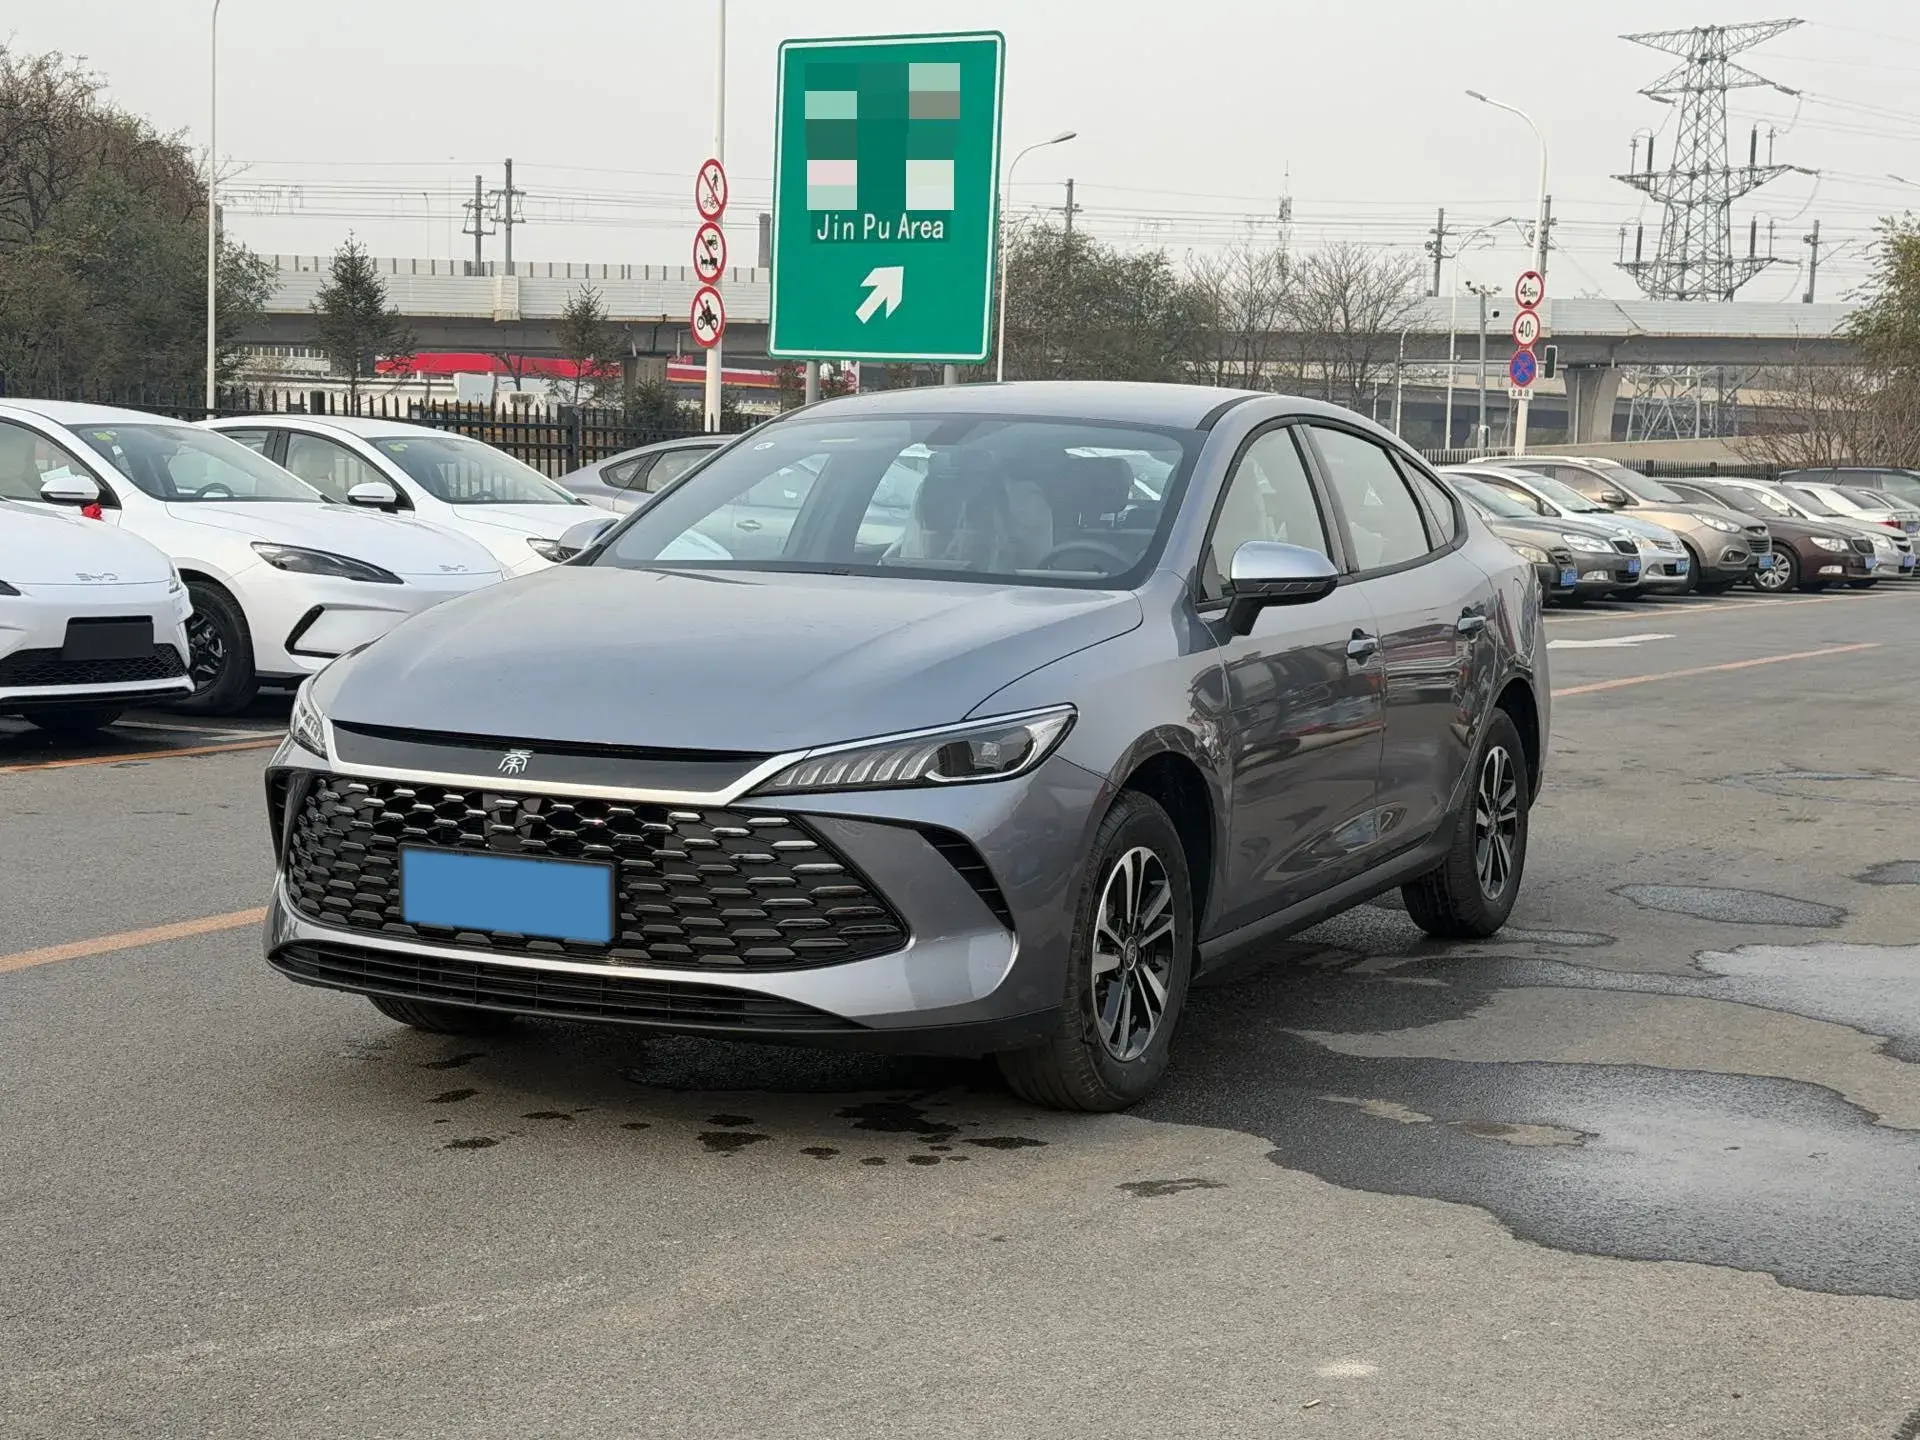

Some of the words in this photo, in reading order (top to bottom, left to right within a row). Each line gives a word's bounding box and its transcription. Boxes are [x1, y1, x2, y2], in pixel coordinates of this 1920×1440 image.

[817, 213, 854, 240] Jin
[863, 213, 890, 240] Pu
[897, 212, 944, 240] Area
